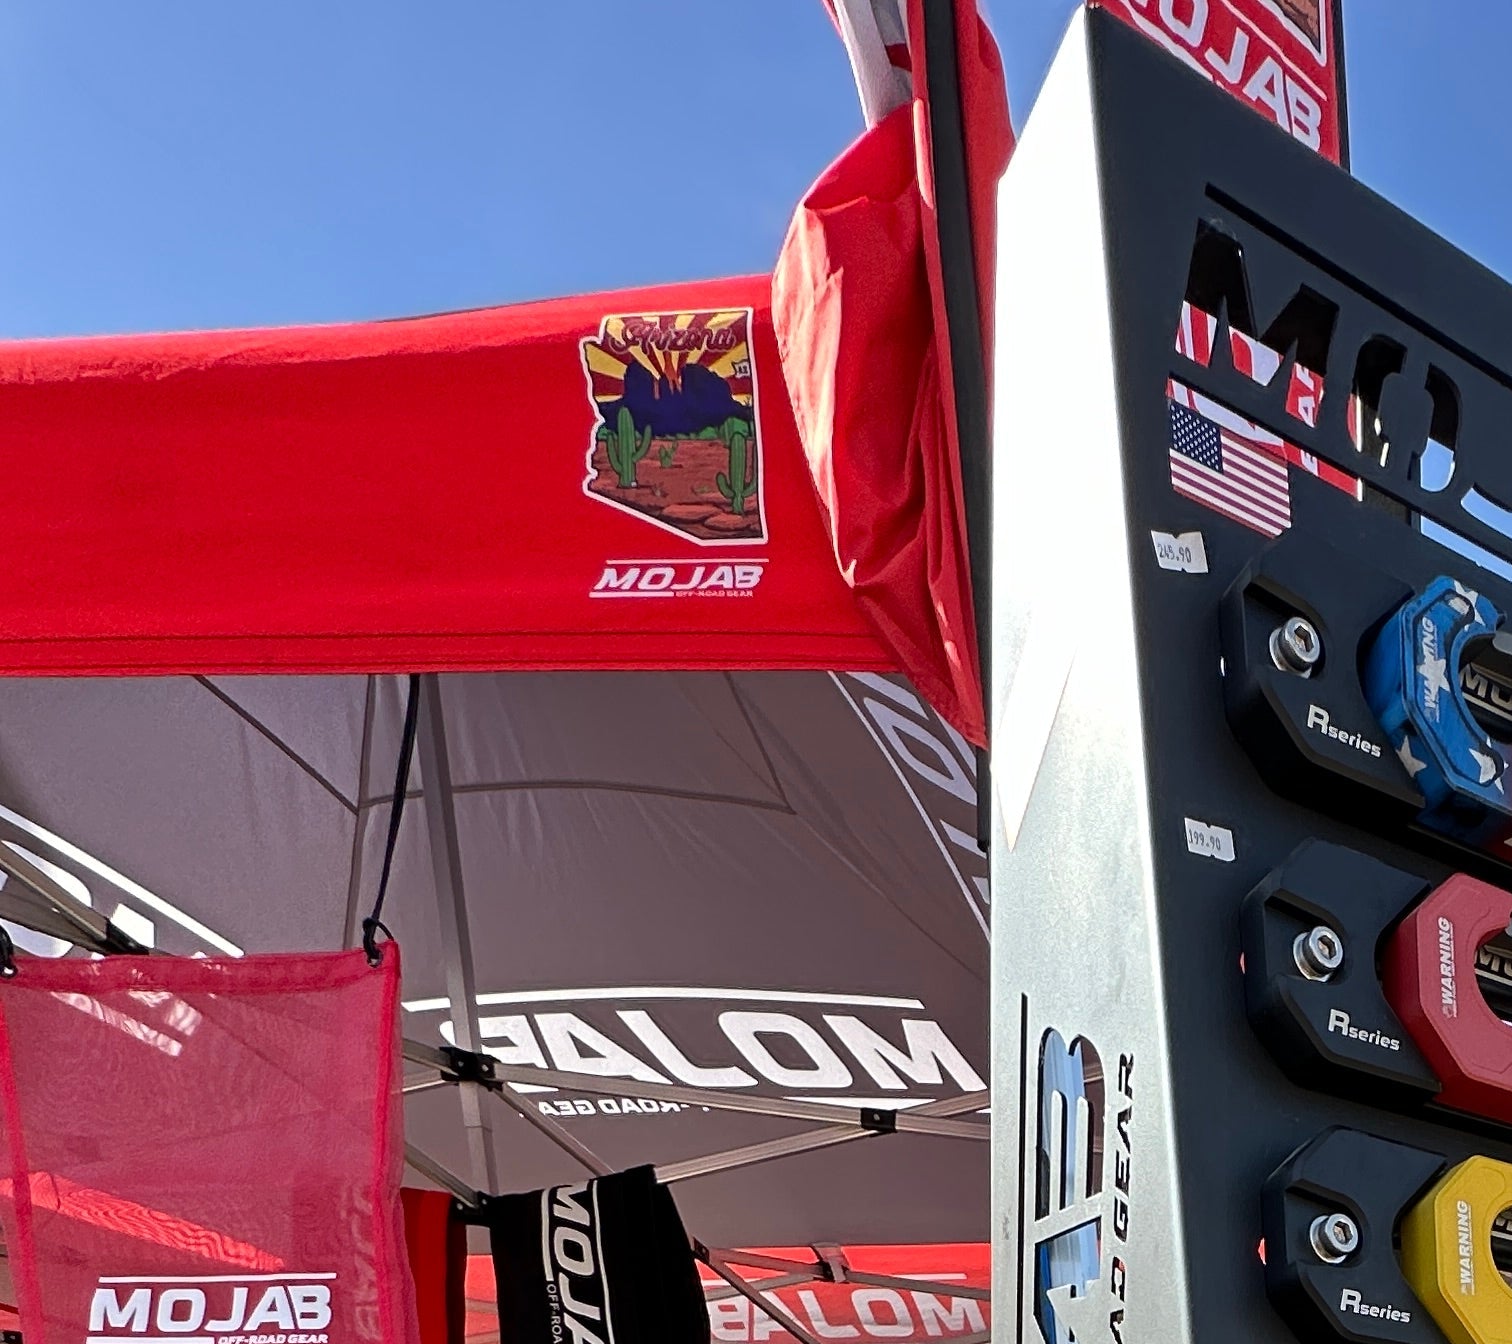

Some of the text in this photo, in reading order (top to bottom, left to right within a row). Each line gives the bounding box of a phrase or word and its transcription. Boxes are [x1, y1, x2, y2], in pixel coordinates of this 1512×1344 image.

[607, 321, 738, 354] Arizona
[593, 564, 765, 590] MOJAB
[1439, 916, 1451, 1006] WARNING
[1113, 1051, 1136, 1243] GEAR
[1458, 1200, 1470, 1287] WARNING
[87, 1284, 333, 1333] MOJAB
[287, 1333, 329, 1344] GEAR
